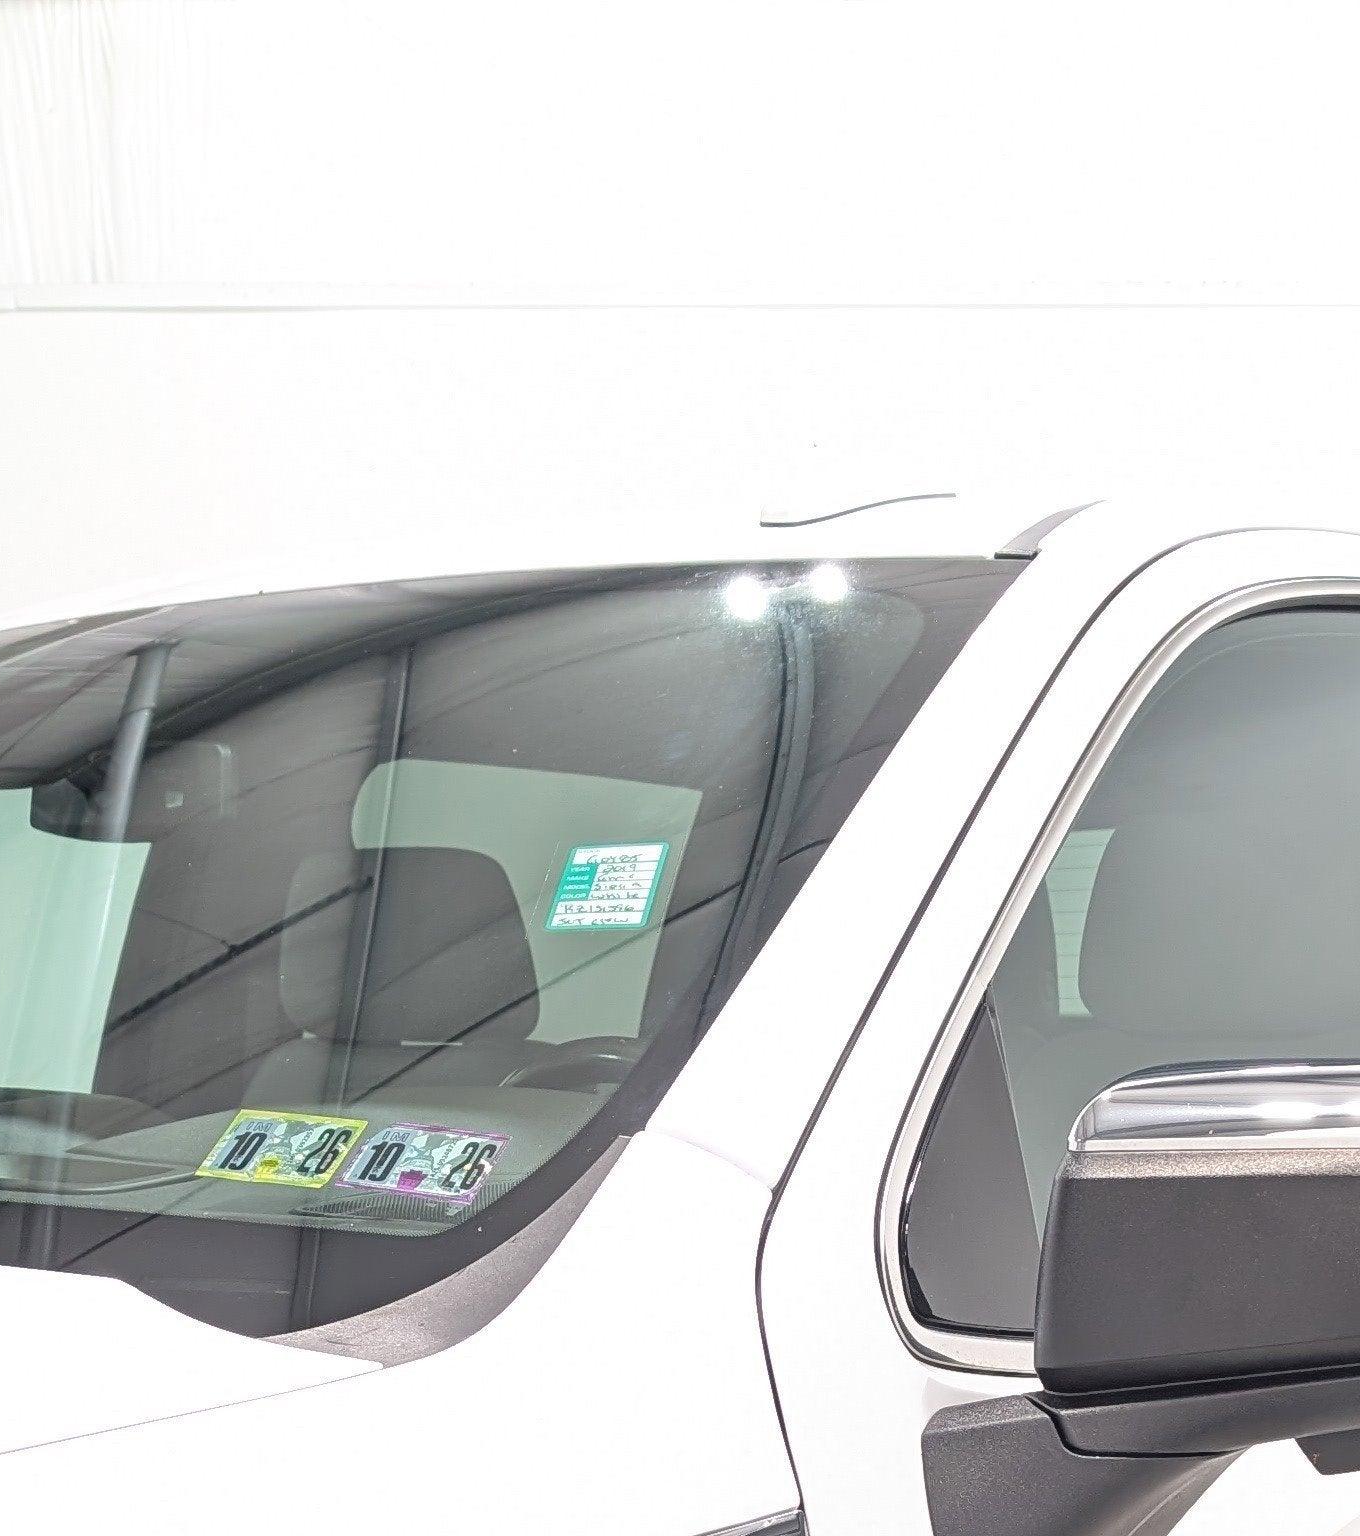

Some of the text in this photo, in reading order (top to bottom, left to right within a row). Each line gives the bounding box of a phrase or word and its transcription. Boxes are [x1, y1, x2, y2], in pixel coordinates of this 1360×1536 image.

[603, 864, 637, 875] 2019
[297, 1126, 353, 1175] 26
[440, 1141, 497, 1190] 26
